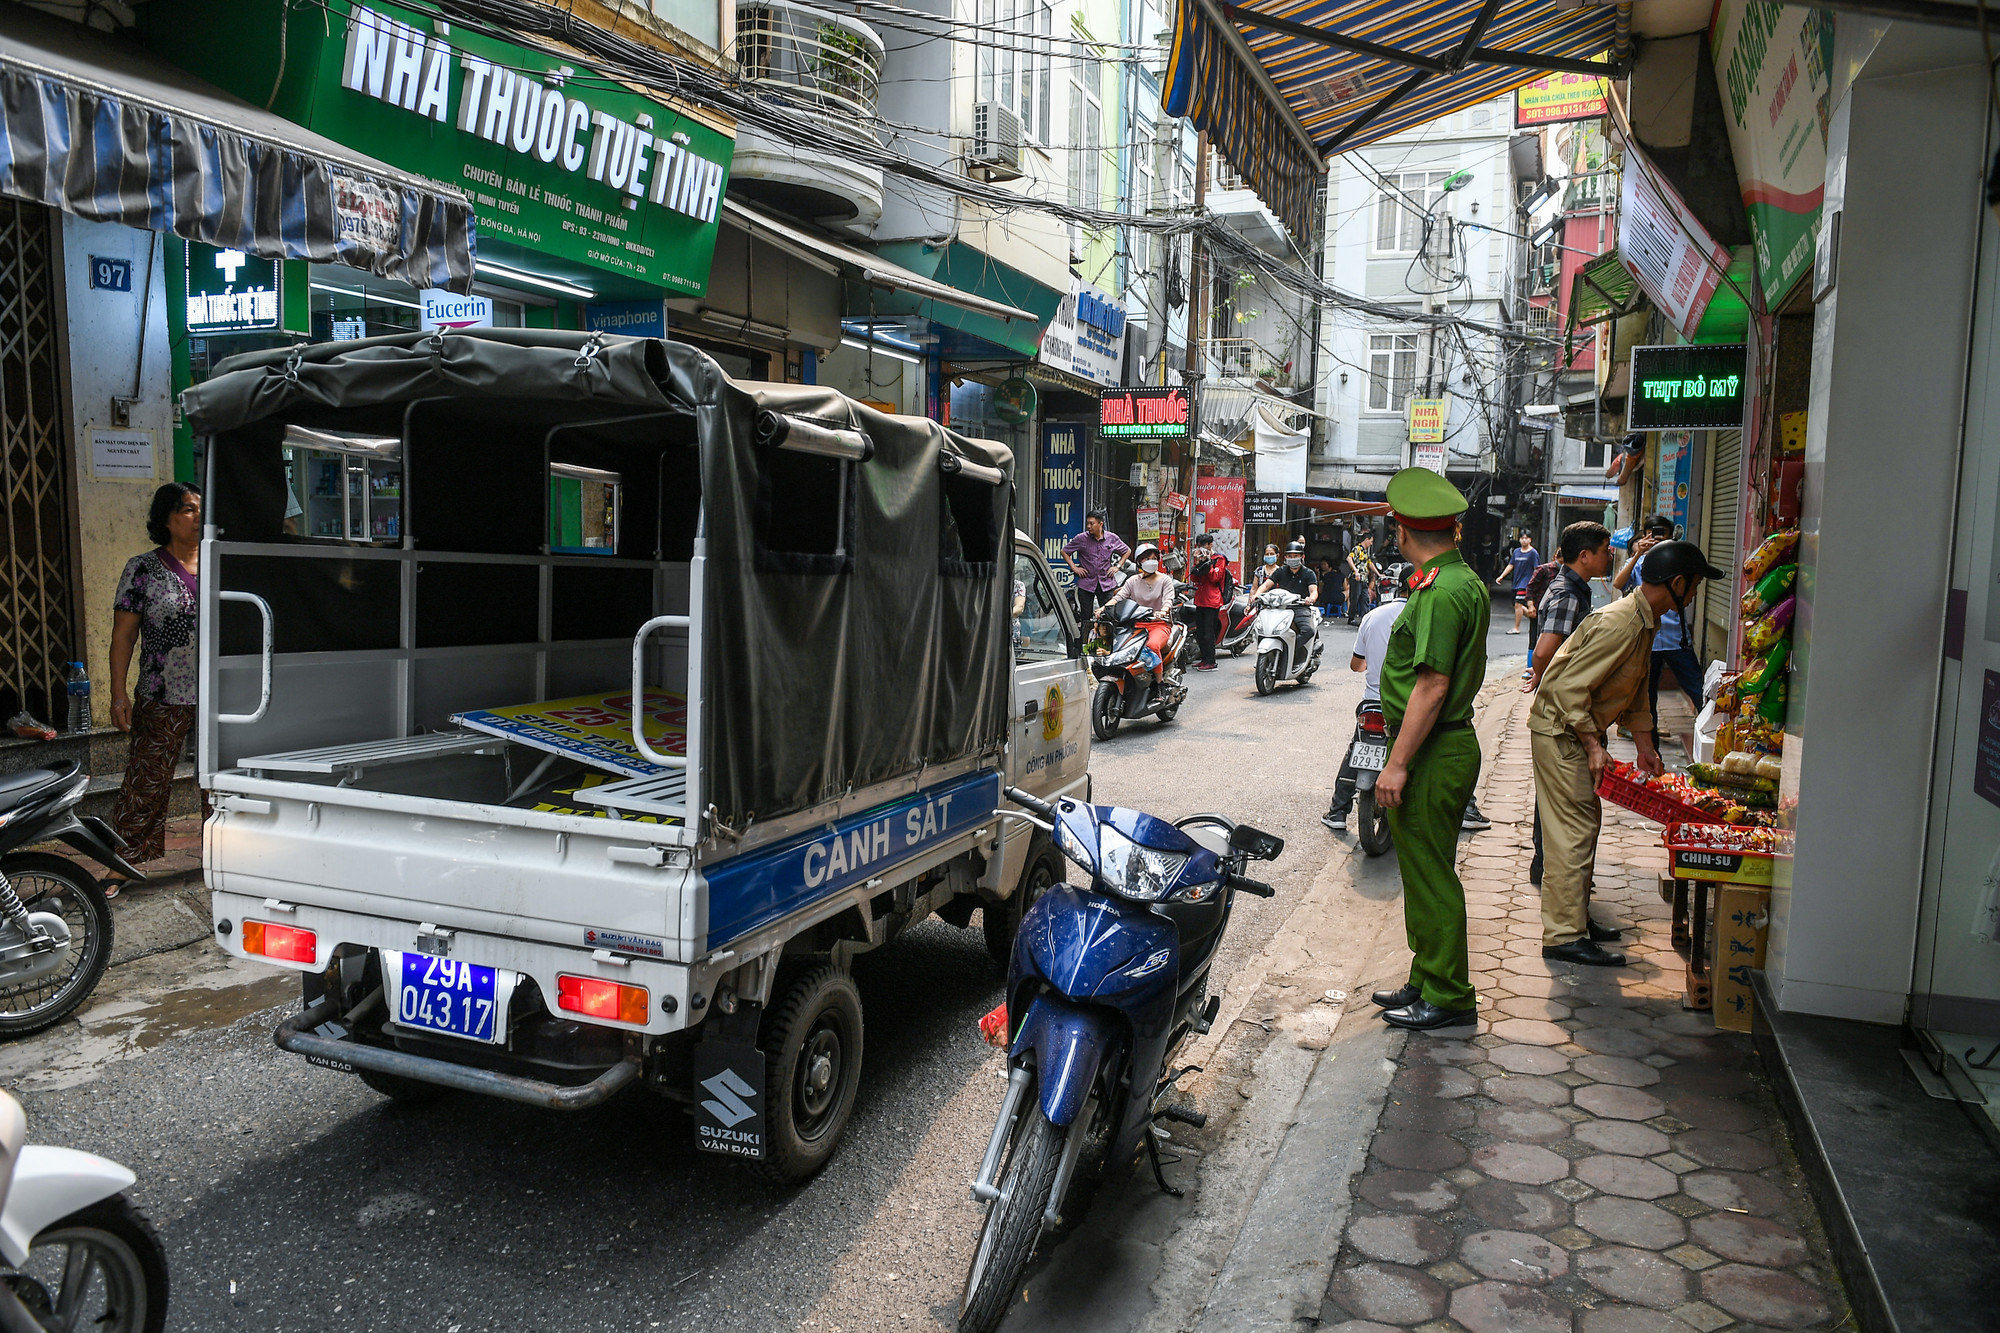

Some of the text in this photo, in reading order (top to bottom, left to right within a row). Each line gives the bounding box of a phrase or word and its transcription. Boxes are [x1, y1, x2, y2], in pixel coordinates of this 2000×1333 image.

[342, 4, 724, 223] NHÀ THUỐC TUỆ TĨNH
[463, 163, 503, 189] CHUYÊN
[529, 183, 541, 201] LẺ
[543, 191, 572, 212] THUỐC
[575, 201, 602, 223] THÀNH
[604, 212, 628, 232] PHẨM
[477, 193, 496, 208] MINH
[503, 224, 516, 236] ĐA,
[517, 227, 528, 238] HÀ
[529, 230, 541, 243] NỘI
[562, 220, 578, 234] GPS:
[98, 263, 125, 287] 97
[427, 297, 486, 319] Eucerin
[593, 310, 658, 329] vinaphone
[1643, 375, 1739, 403] THỊT BÒ MỸ
[1102, 390, 1187, 424] NHÀ THUỐC
[1415, 406, 1438, 416] NHÀ
[1103, 424, 1185, 436] 105 KHƯƠNG THƯỢNG
[1413, 416, 1440, 427] NGHỈ
[1050, 429, 1075, 455] NHÀ
[1043, 461, 1081, 490] THUỐC
[1055, 501, 1071, 525] TƯ
[515, 713, 584, 735] SHIP
[1358, 744, 1386, 757] 29-E1
[1027, 754, 1045, 775] CÔNG
[1045, 751, 1054, 766] AN
[803, 792, 953, 888] CẢNH SÁT
[1681, 852, 1731, 866] CHIN-SU
[1087, 901, 1121, 918] HONDA
[601, 932, 626, 941] SUZUKI
[423, 955, 473, 993] 29A
[402, 985, 493, 1035] 043.17
[700, 1125, 760, 1145] SUZUKI
